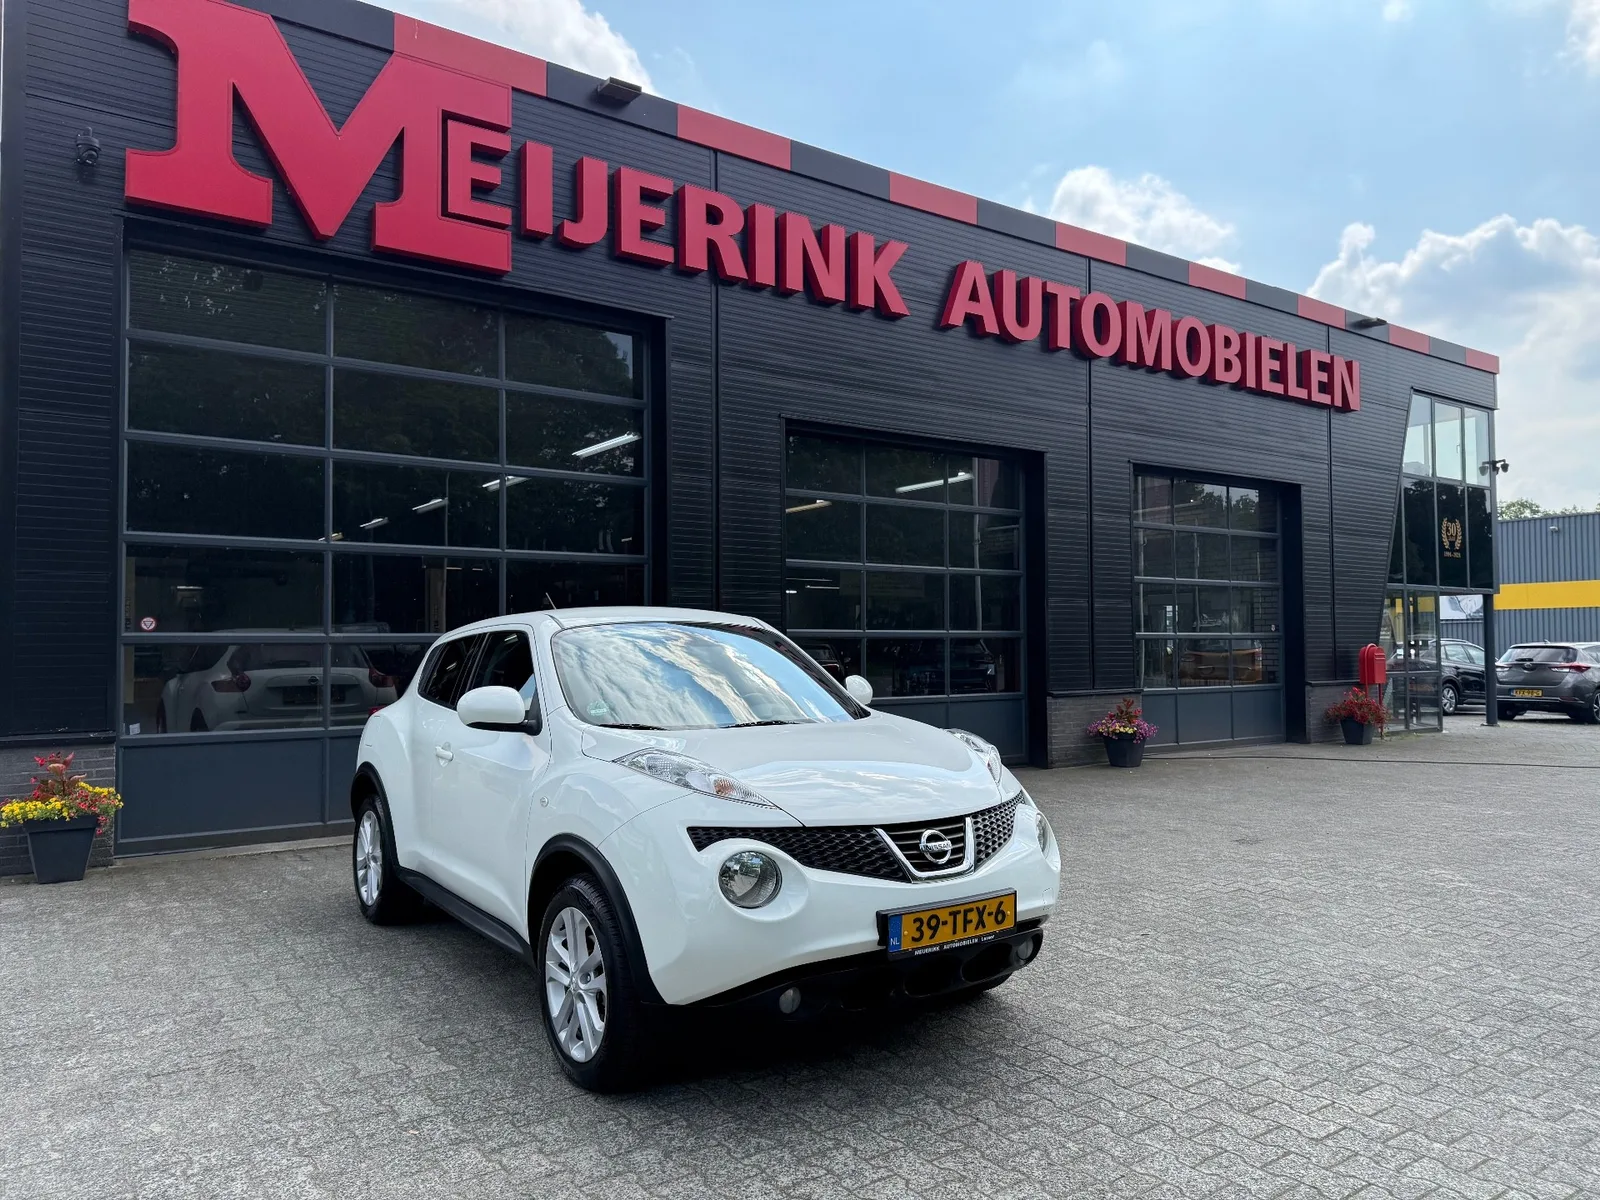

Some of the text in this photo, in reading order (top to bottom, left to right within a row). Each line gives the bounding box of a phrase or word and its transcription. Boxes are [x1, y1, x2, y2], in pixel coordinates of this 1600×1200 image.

[124, 0, 1360, 411] MEIJERINK AUTOMOBIELEN
[1446, 522, 1457, 537] 30
[926, 841, 951, 851] NISSAN
[911, 900, 1007, 943] 39-TFX-6
[890, 937, 900, 946] NL
